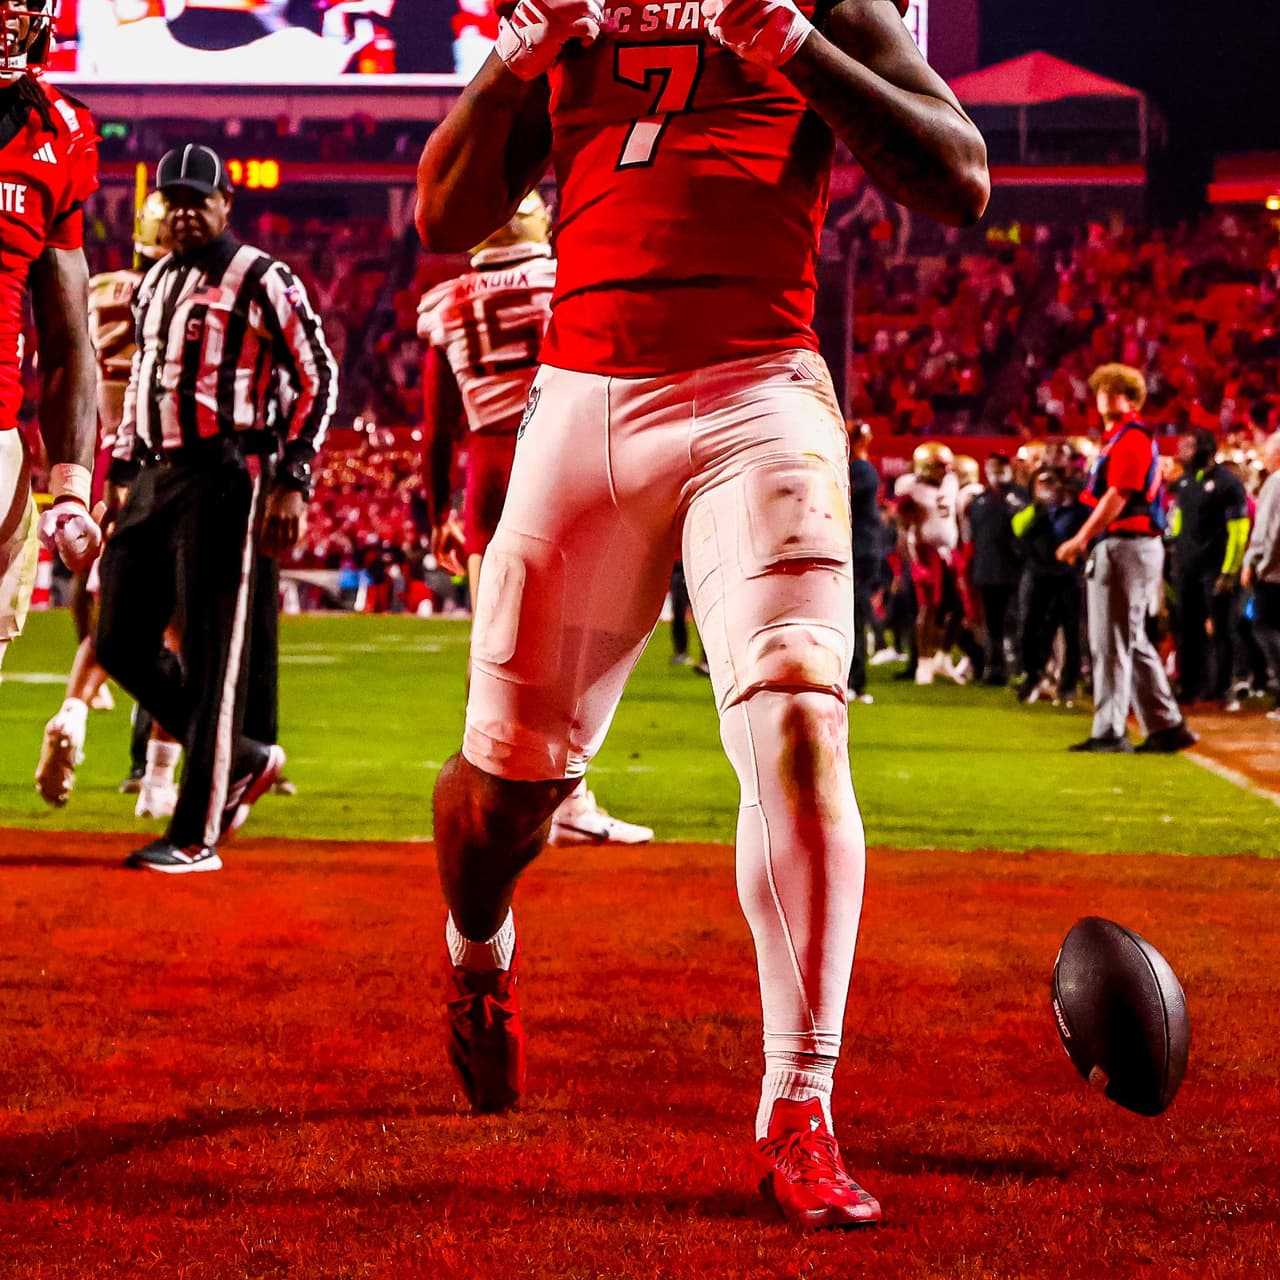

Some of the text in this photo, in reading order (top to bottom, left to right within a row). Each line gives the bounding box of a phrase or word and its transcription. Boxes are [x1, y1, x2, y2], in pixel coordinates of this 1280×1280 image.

[613, 40, 705, 171] 7
[185, 318, 202, 341] S
[1051, 998, 1072, 1039] DIME
